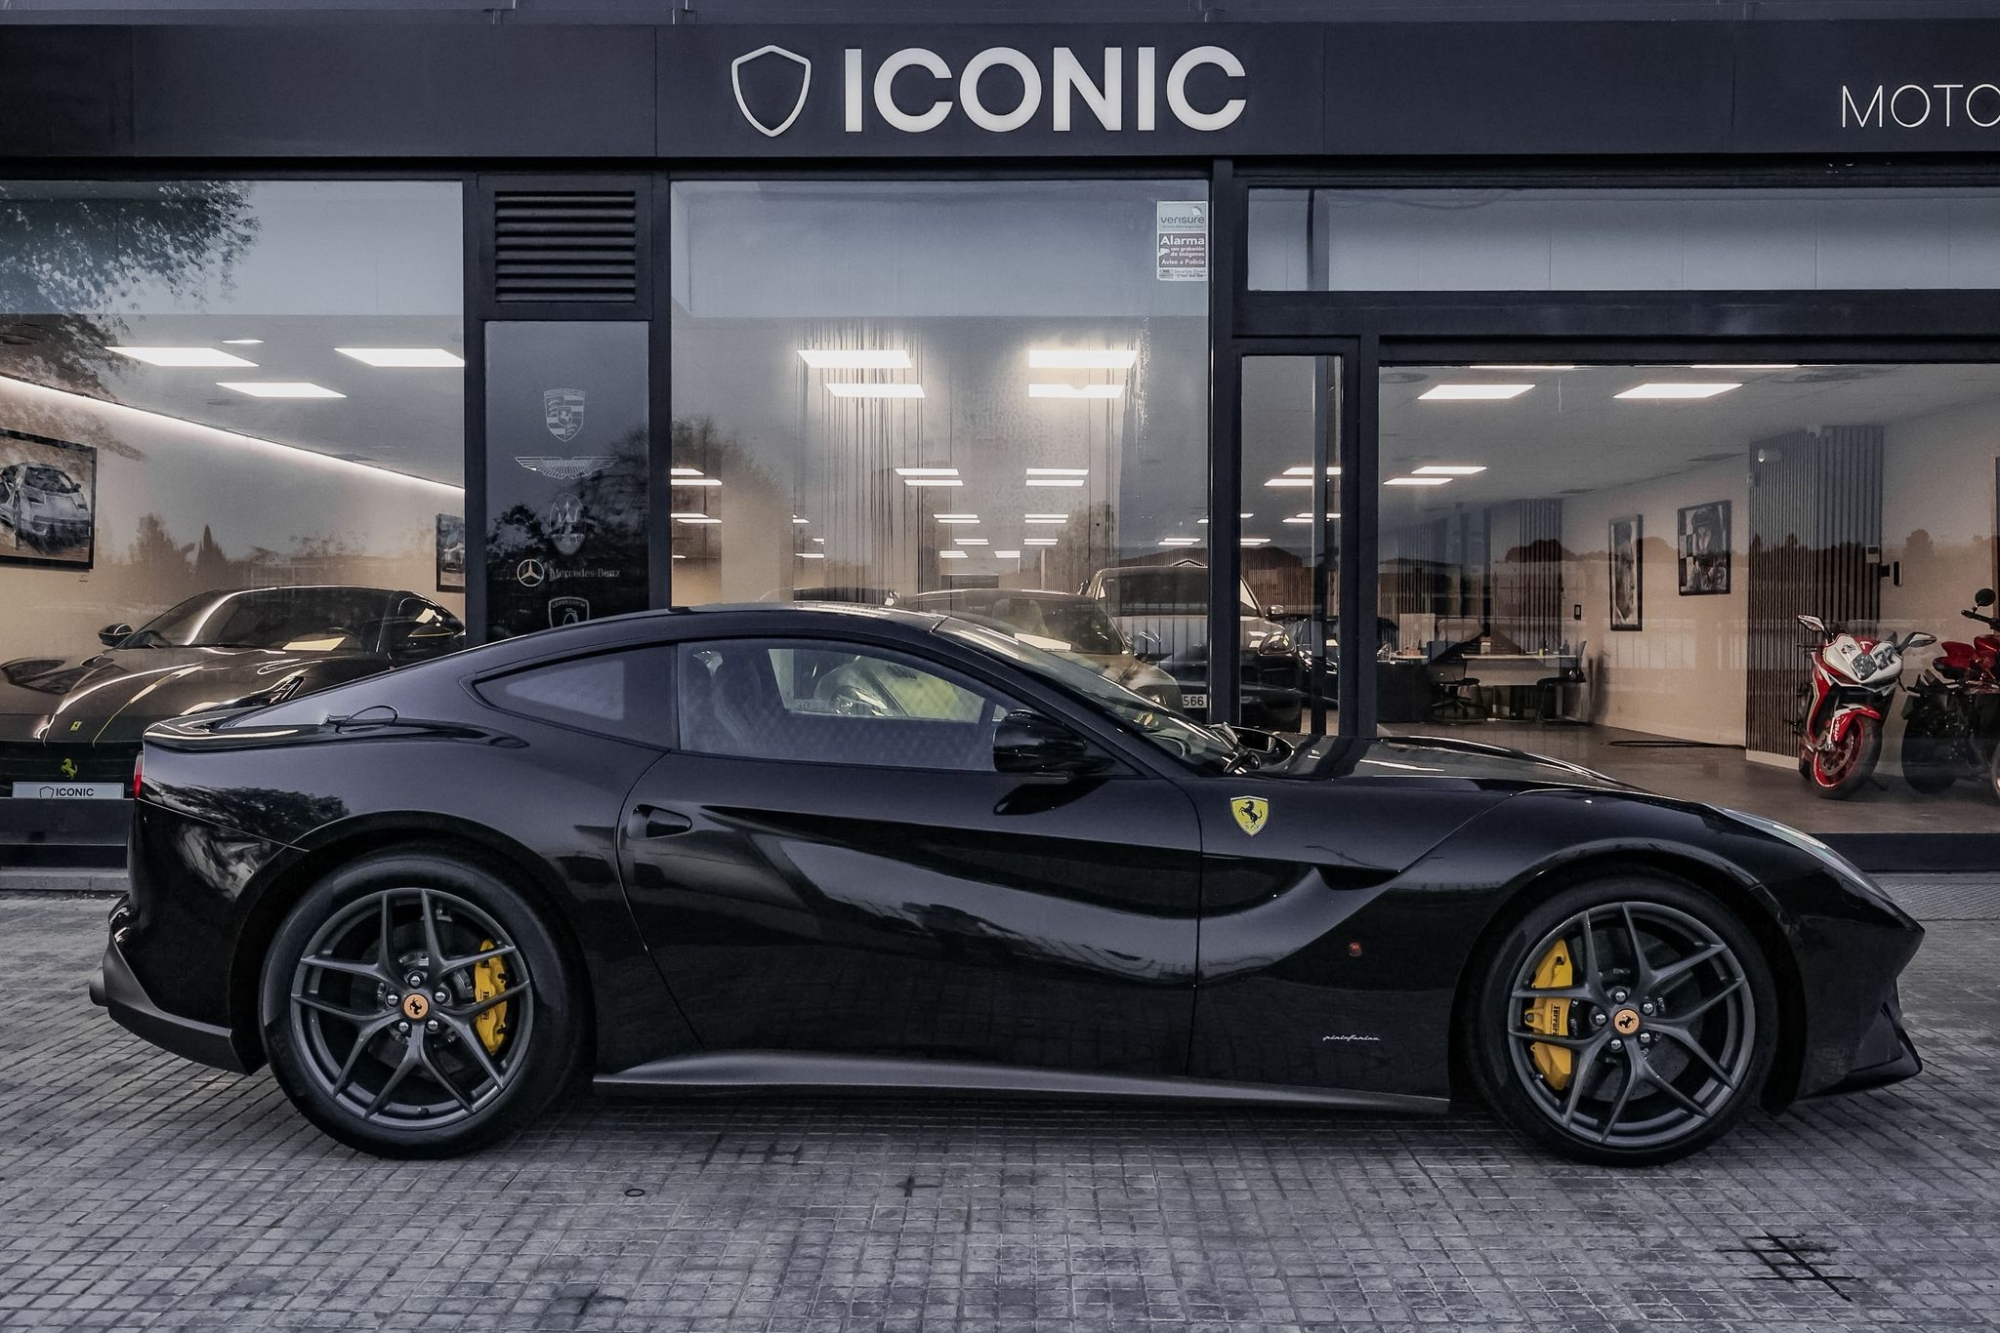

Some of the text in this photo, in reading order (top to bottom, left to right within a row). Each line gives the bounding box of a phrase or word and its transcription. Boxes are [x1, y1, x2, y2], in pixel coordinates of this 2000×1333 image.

[845, 46, 1247, 133] ICONIC
[1842, 84, 2000, 128] MOTO
[1160, 216, 1204, 224] verisure
[1160, 235, 1205, 245] Alarma
[549, 568, 621, 578] Mercedes-Benz
[1183, 695, 1204, 706] 566
[56, 788, 94, 797] ICONIC
